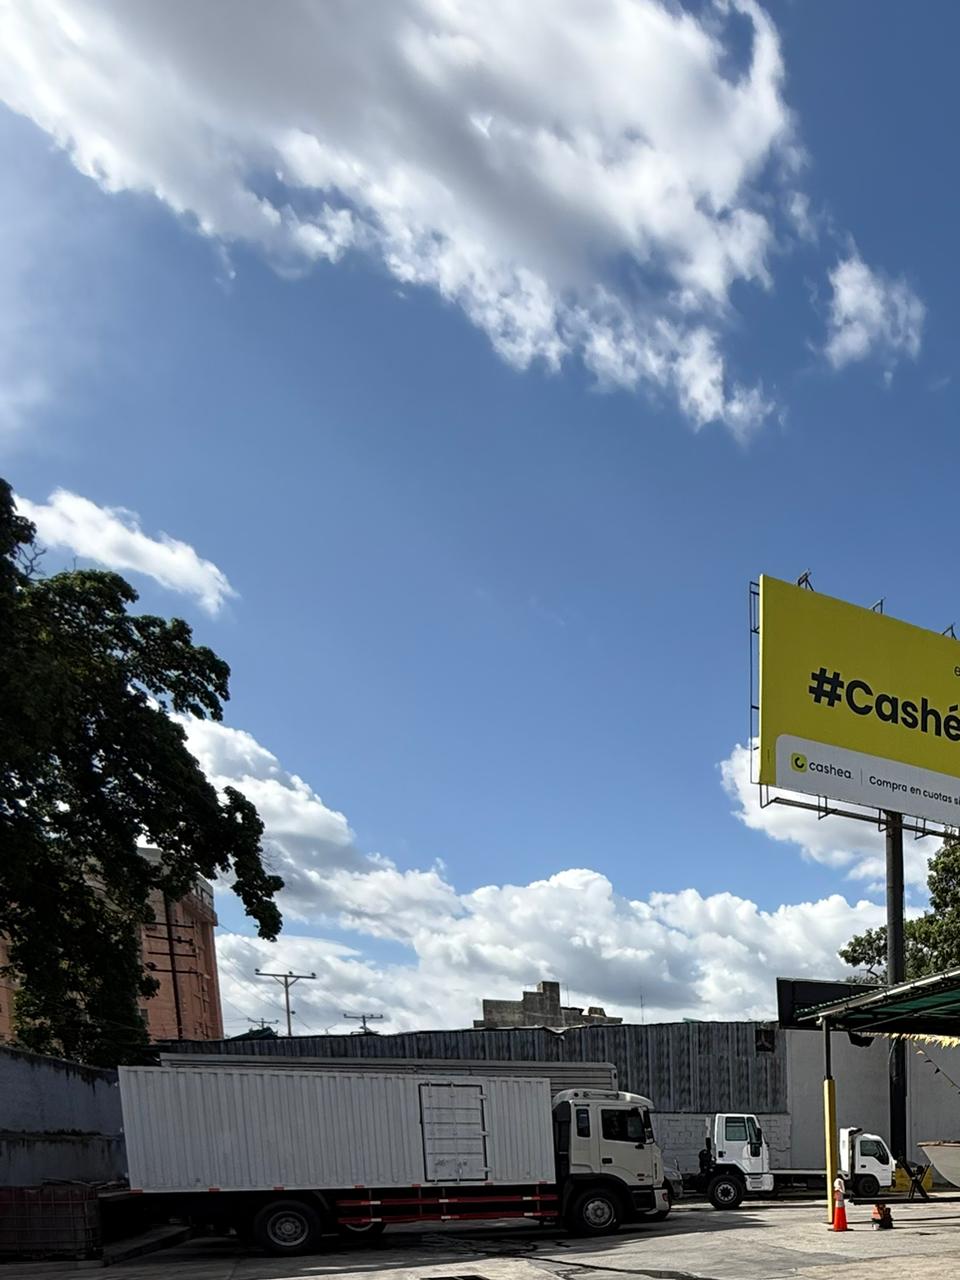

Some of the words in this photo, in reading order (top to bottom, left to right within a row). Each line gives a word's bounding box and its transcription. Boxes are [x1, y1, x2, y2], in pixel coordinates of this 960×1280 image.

[869, 775, 907, 792] Compra
[910, 784, 922, 796] en
[923, 789, 952, 804] cuotas
